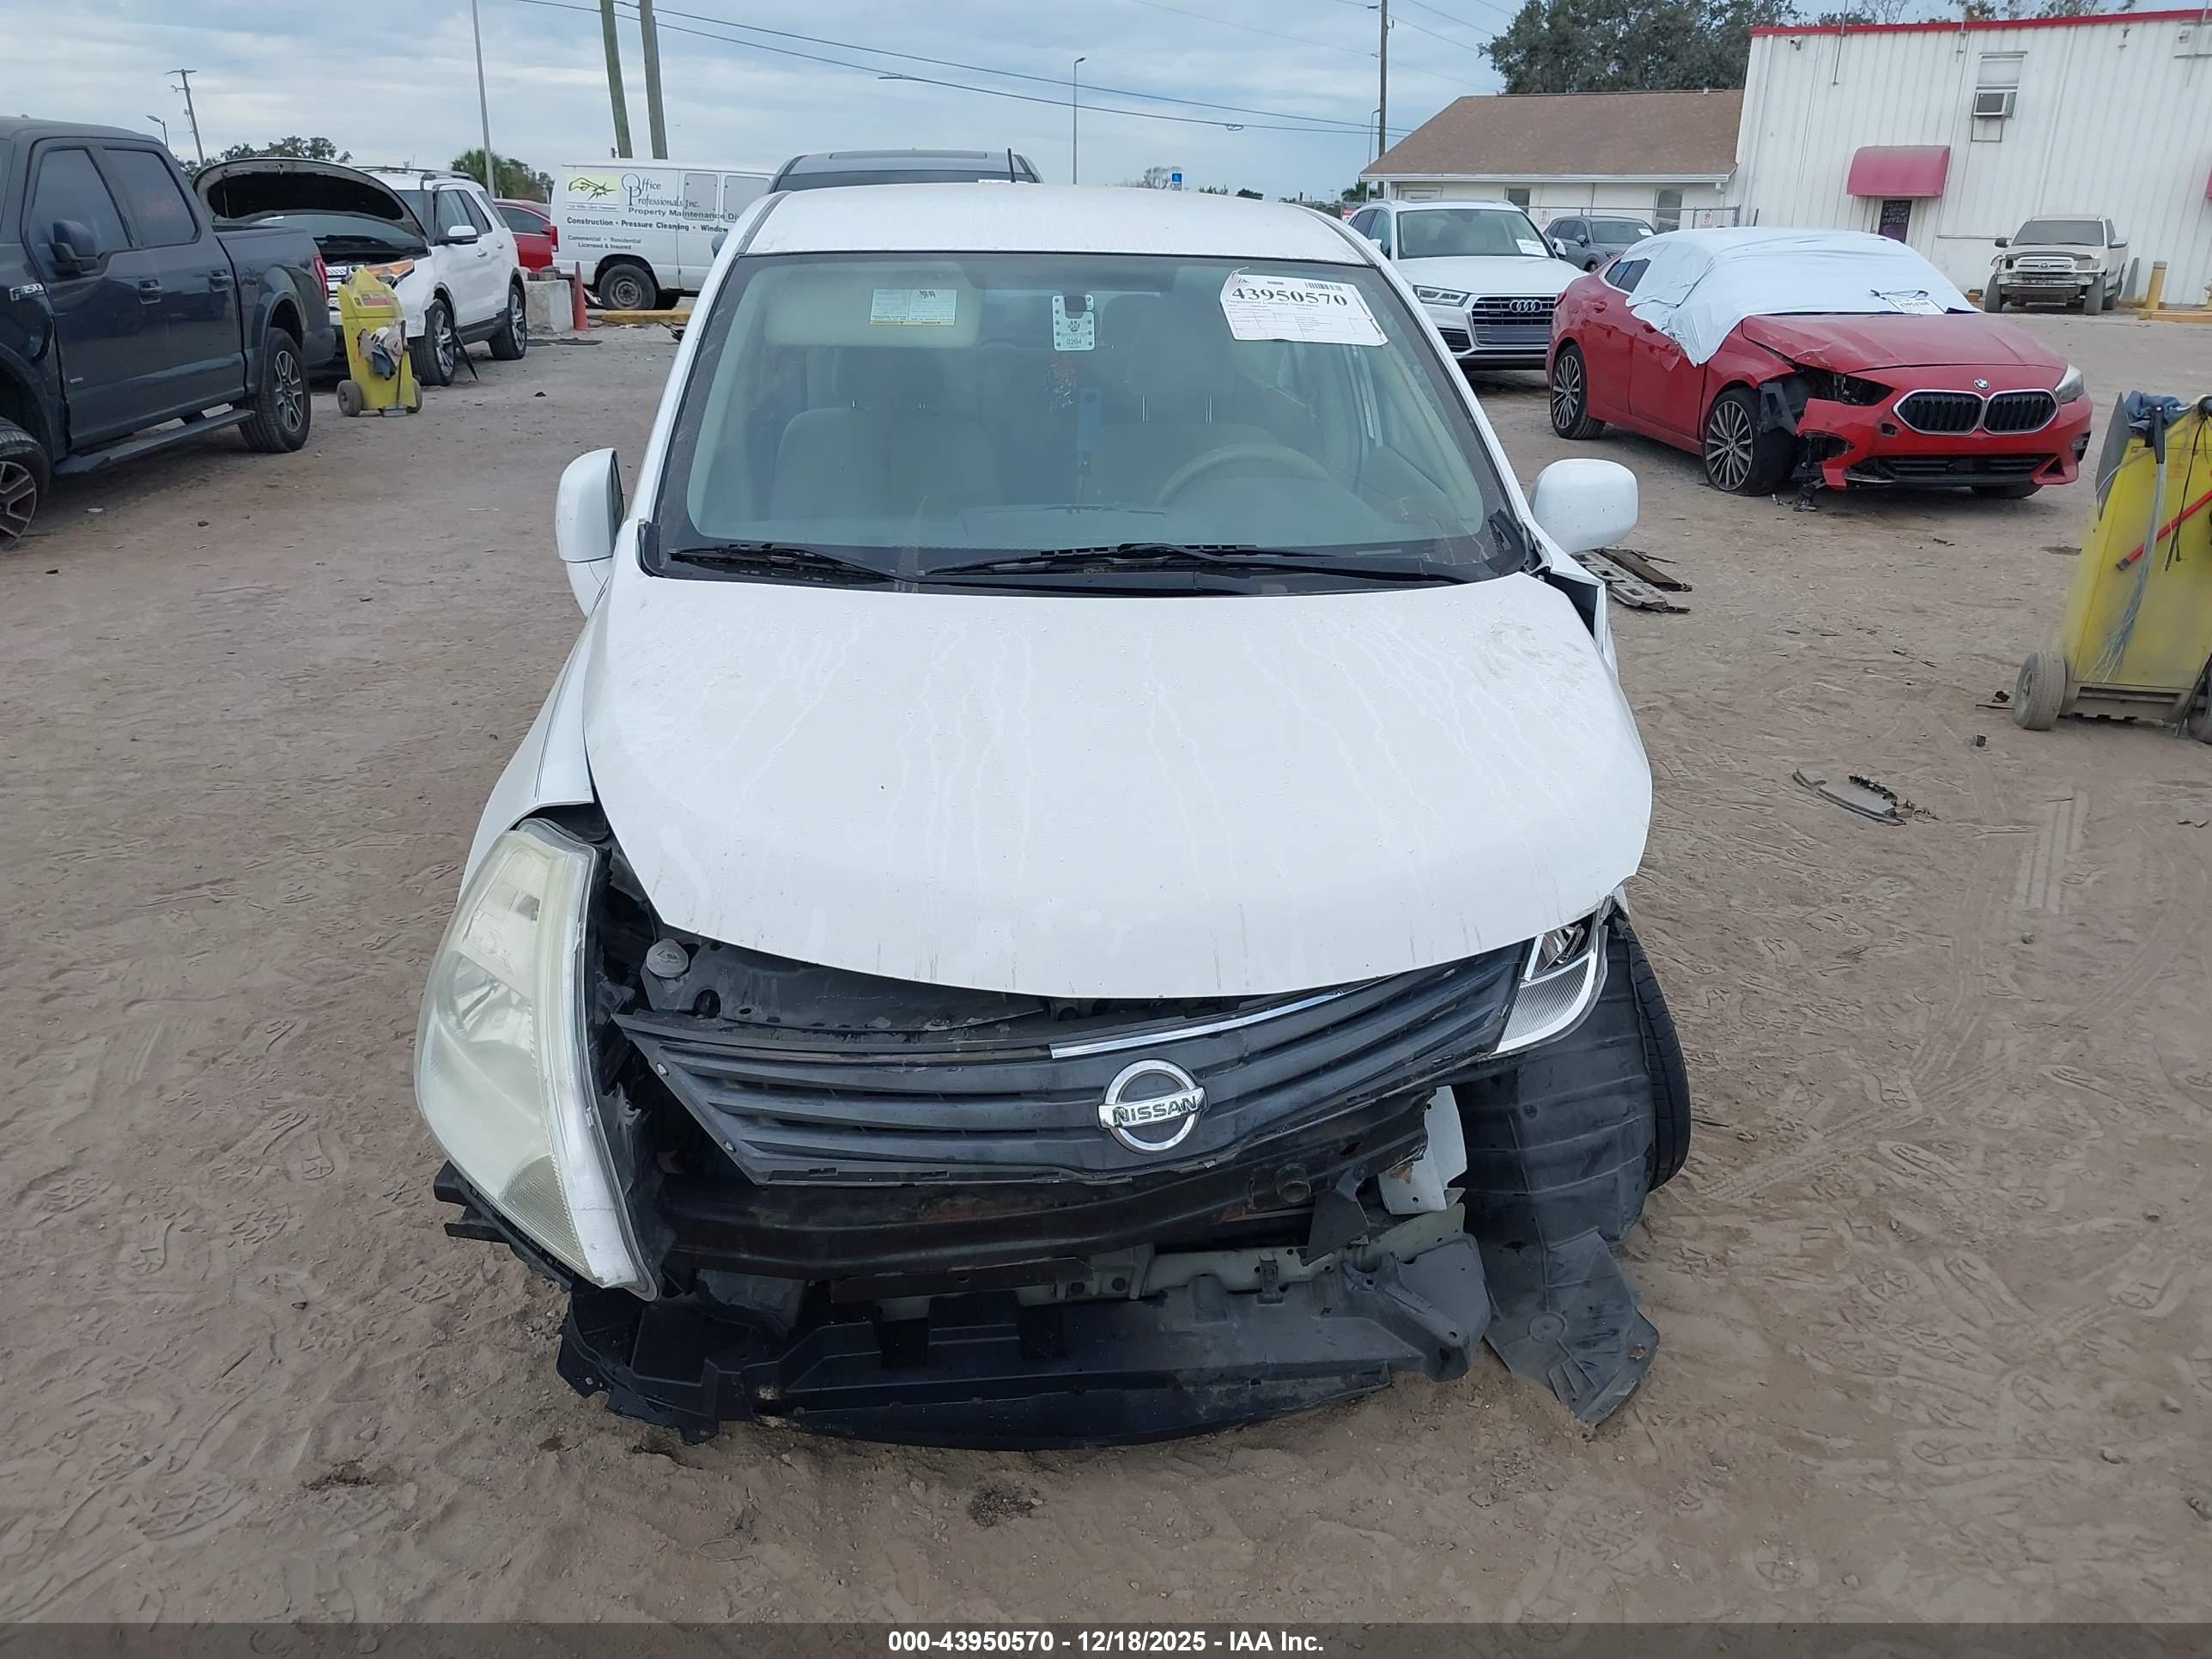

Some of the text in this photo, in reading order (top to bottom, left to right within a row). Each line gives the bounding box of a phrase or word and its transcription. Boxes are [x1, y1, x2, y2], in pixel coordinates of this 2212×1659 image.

[622, 173, 661, 192] Office
[627, 185, 684, 207] Professionals
[628, 207, 666, 217] Property
[669, 210, 726, 220] Maintenance
[567, 216, 614, 226] Construction
[621, 219, 653, 228] Pressure
[656, 221, 690, 231] Cleaning
[610, 236, 642, 245] Residential
[1231, 288, 1348, 307] 43950570
[1112, 1096, 1197, 1127] NISSAN
